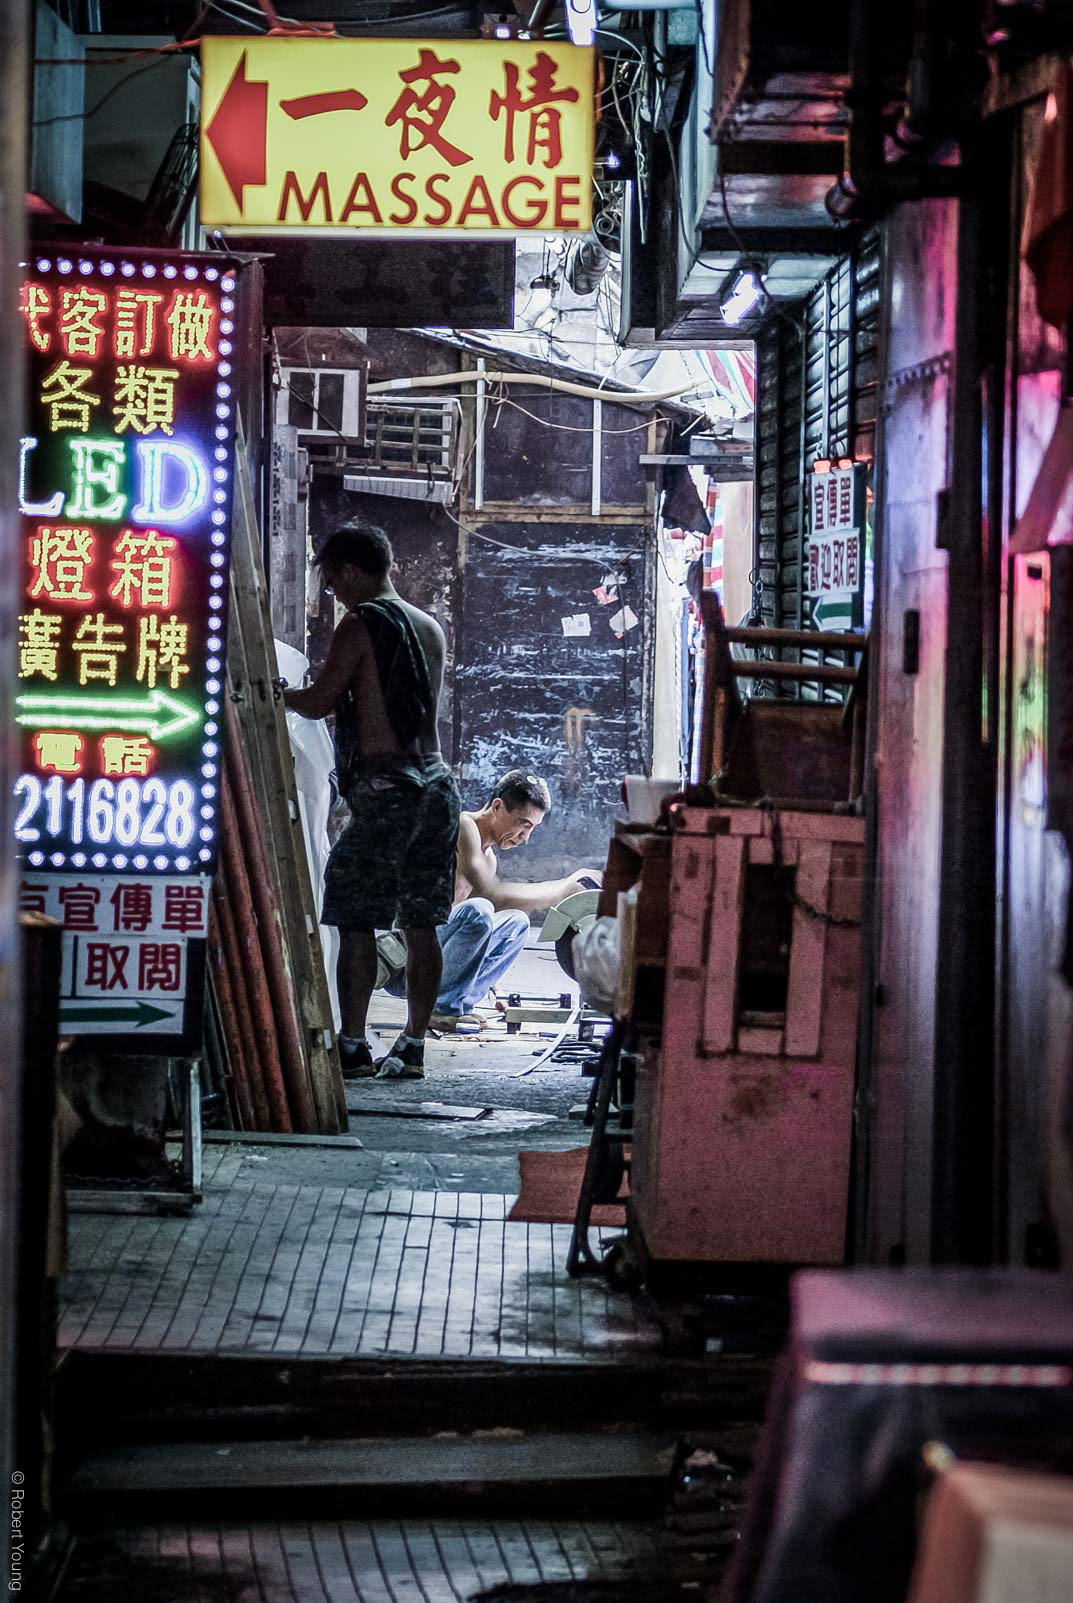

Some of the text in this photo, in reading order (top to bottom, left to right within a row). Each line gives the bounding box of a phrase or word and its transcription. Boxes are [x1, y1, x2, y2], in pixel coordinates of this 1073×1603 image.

[279, 48, 580, 169] 一夜情
[278, 171, 581, 228] MASSAGE
[41, 361, 179, 436] 各類
[19, 436, 208, 521] LED
[30, 527, 175, 607] 燈箱
[18, 608, 190, 688] 廣告牌
[36, 733, 152, 775] 電話
[14, 775, 196, 847] 2116828
